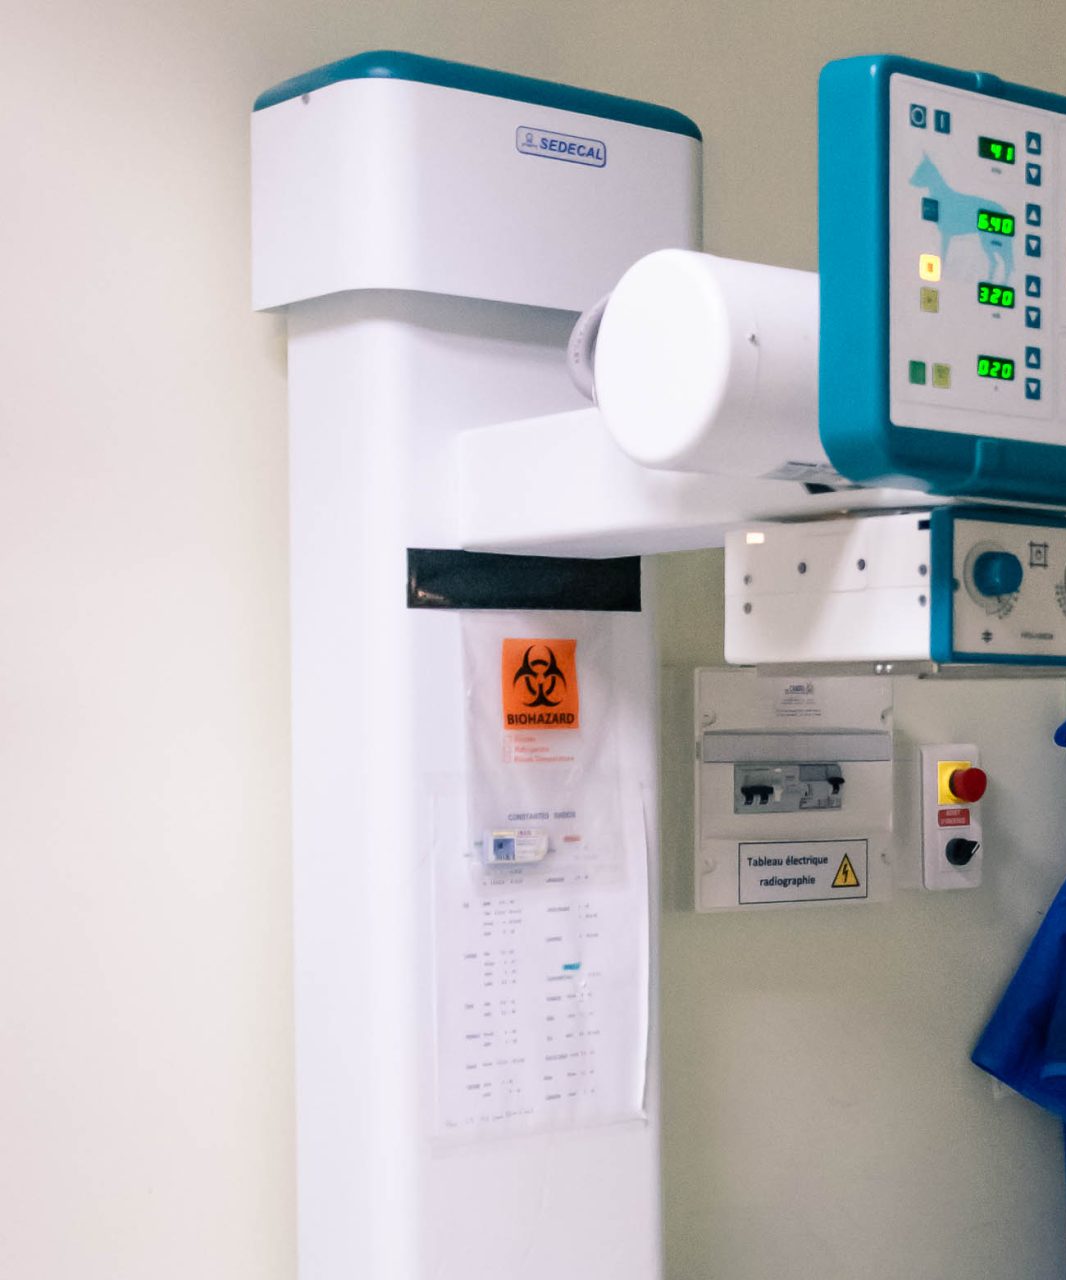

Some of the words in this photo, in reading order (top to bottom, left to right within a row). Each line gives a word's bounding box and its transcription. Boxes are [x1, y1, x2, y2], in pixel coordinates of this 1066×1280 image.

[540, 137, 603, 161] SEDECAL
[990, 143, 1014, 161] 41
[979, 287, 1013, 306] 320
[507, 712, 575, 725] BIOHAZARD
[747, 856, 783, 867] Tableau
[785, 855, 828, 866] électrique
[760, 875, 816, 888] radiographie
